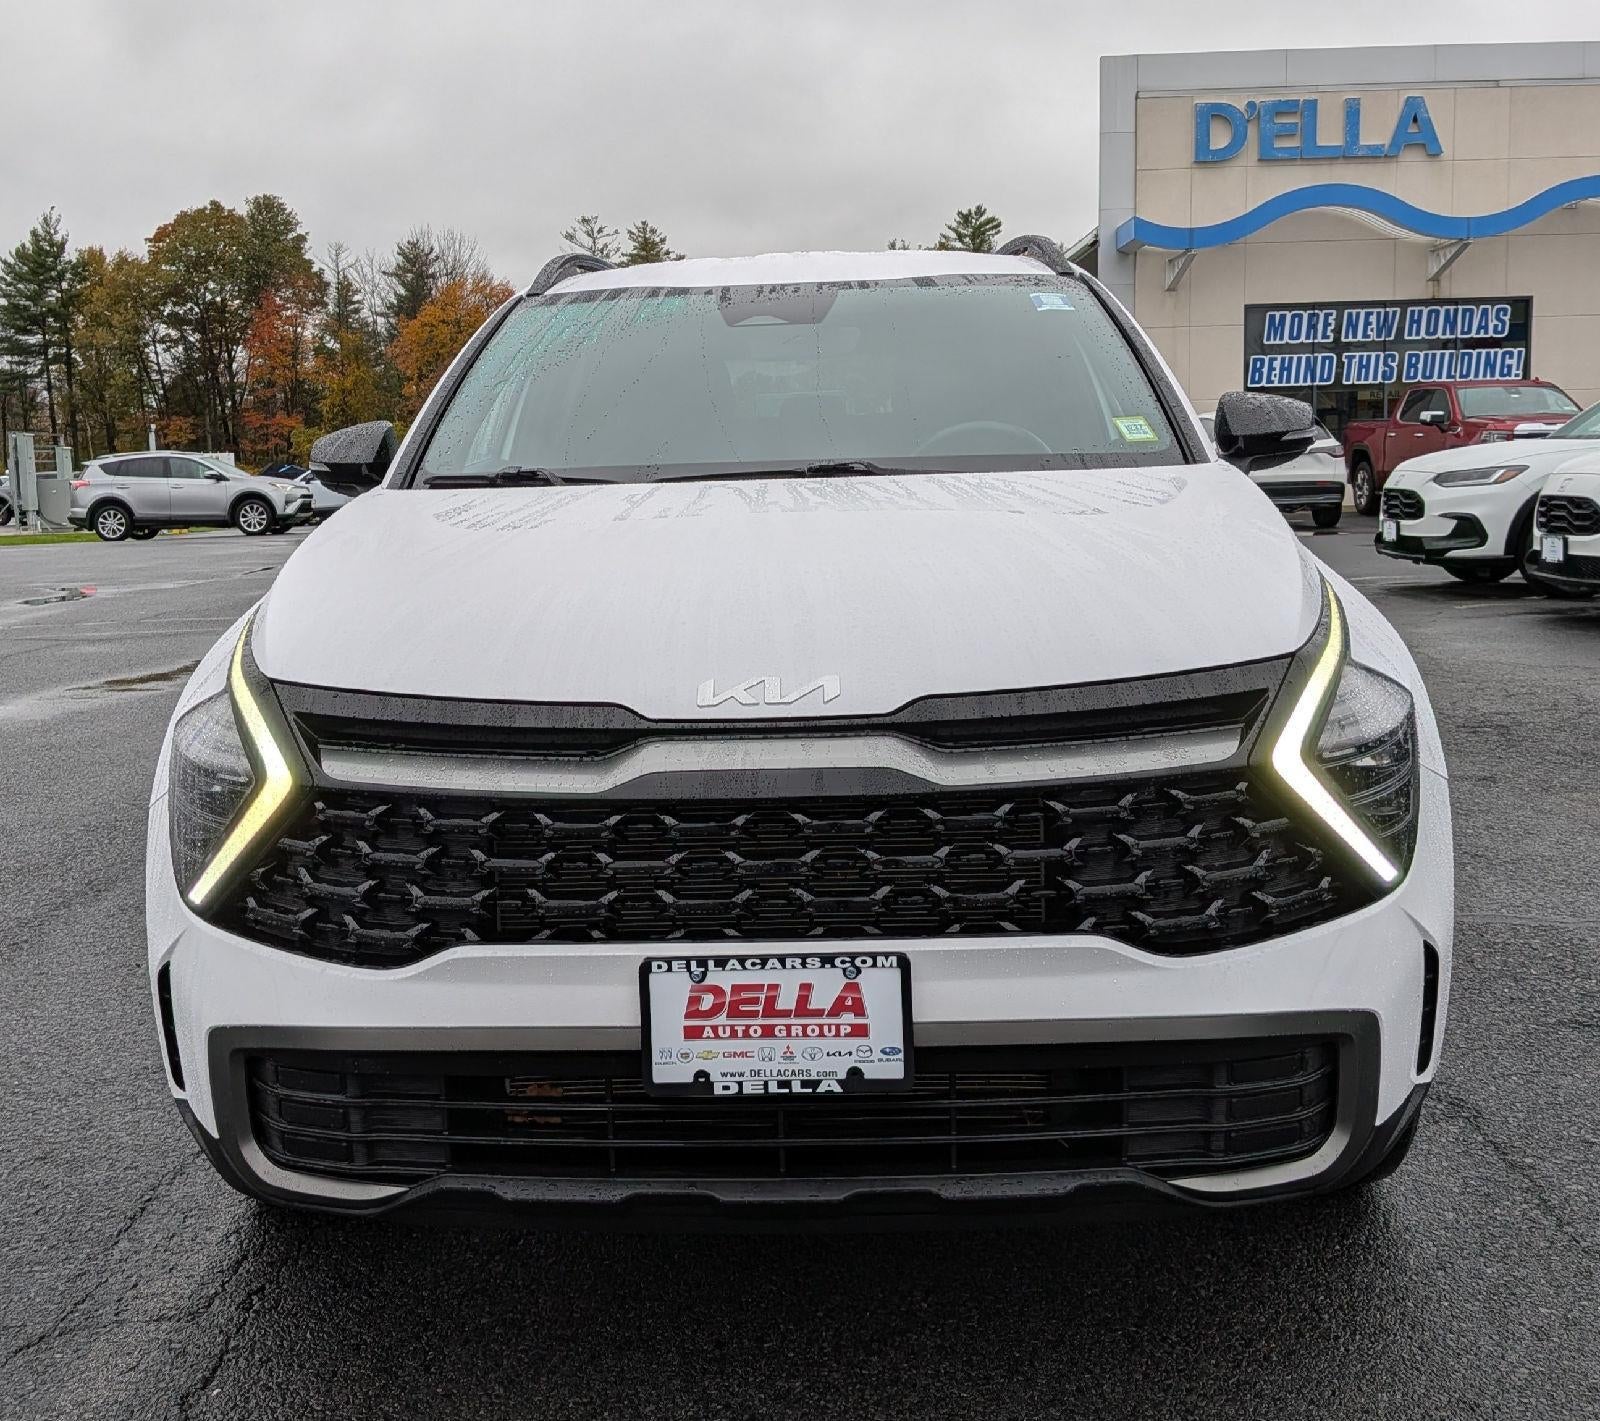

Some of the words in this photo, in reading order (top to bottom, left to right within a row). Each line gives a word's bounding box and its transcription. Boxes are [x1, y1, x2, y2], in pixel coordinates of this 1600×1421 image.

[1193, 95, 1444, 163] D'ELLA
[1264, 310, 1336, 344] MORE
[1341, 307, 1399, 342] NEW
[1404, 305, 1511, 340] HONDAS
[1247, 353, 1337, 387] BEHIND
[1342, 352, 1398, 384] THIS
[1402, 348, 1525, 383] BUILDING!
[651, 956, 898, 973] DELLACARS.COM
[683, 981, 869, 1021] DELLA
[702, 1025, 762, 1038] AUTO
[774, 1025, 852, 1038] GROUP
[722, 1050, 755, 1058] GMC
[720, 1069, 838, 1078] www.DELLACARS.com
[714, 1080, 843, 1095] DELLA
